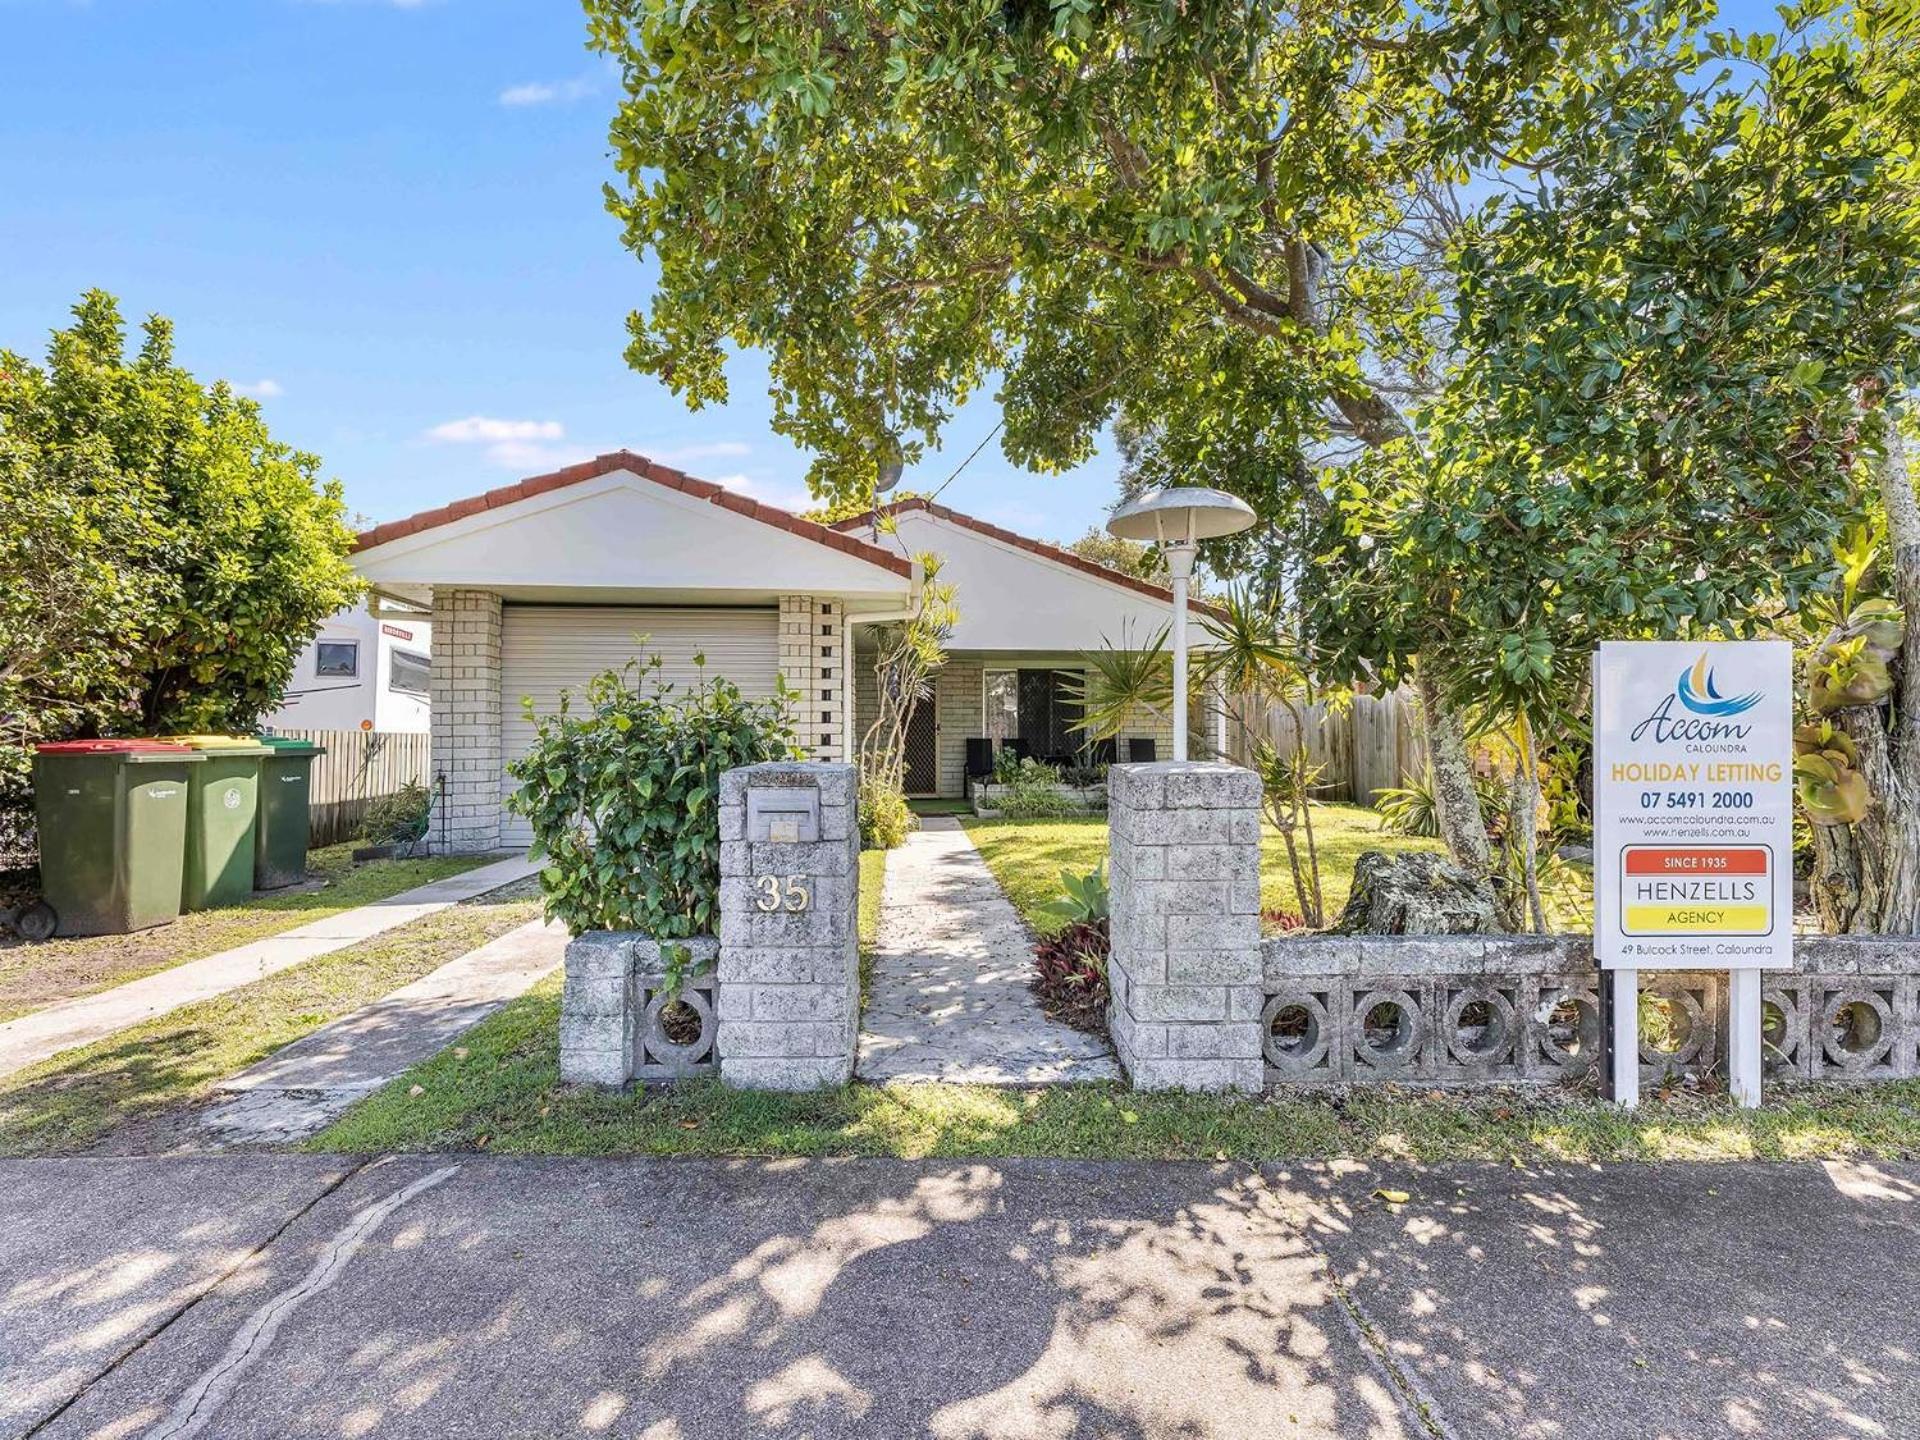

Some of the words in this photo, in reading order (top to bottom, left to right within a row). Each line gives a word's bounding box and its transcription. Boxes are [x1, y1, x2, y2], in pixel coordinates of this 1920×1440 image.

[1631, 693, 1752, 743] Accom
[1685, 744, 1747, 753] CALOUNDRA
[1611, 763, 1700, 782] HOLIDAY
[1707, 763, 1782, 782] LETTING
[1640, 792, 1661, 808] 07
[1666, 792, 1705, 808] 5491
[1712, 792, 1753, 808] 2000
[1618, 815, 1775, 825] www.accomcaloundra.com.au
[1643, 827, 1751, 837] www.henzells.com.au
[1664, 857, 1697, 868] SINCE
[1701, 857, 1727, 868] 1935
[756, 875, 810, 912] 35
[1637, 882, 1755, 900] HENZELLS
[1667, 911, 1725, 923] AGENCY
[1621, 945, 1634, 955] 49
[1636, 944, 1677, 955] Bulcock
[1716, 944, 1773, 955] Caloundra
